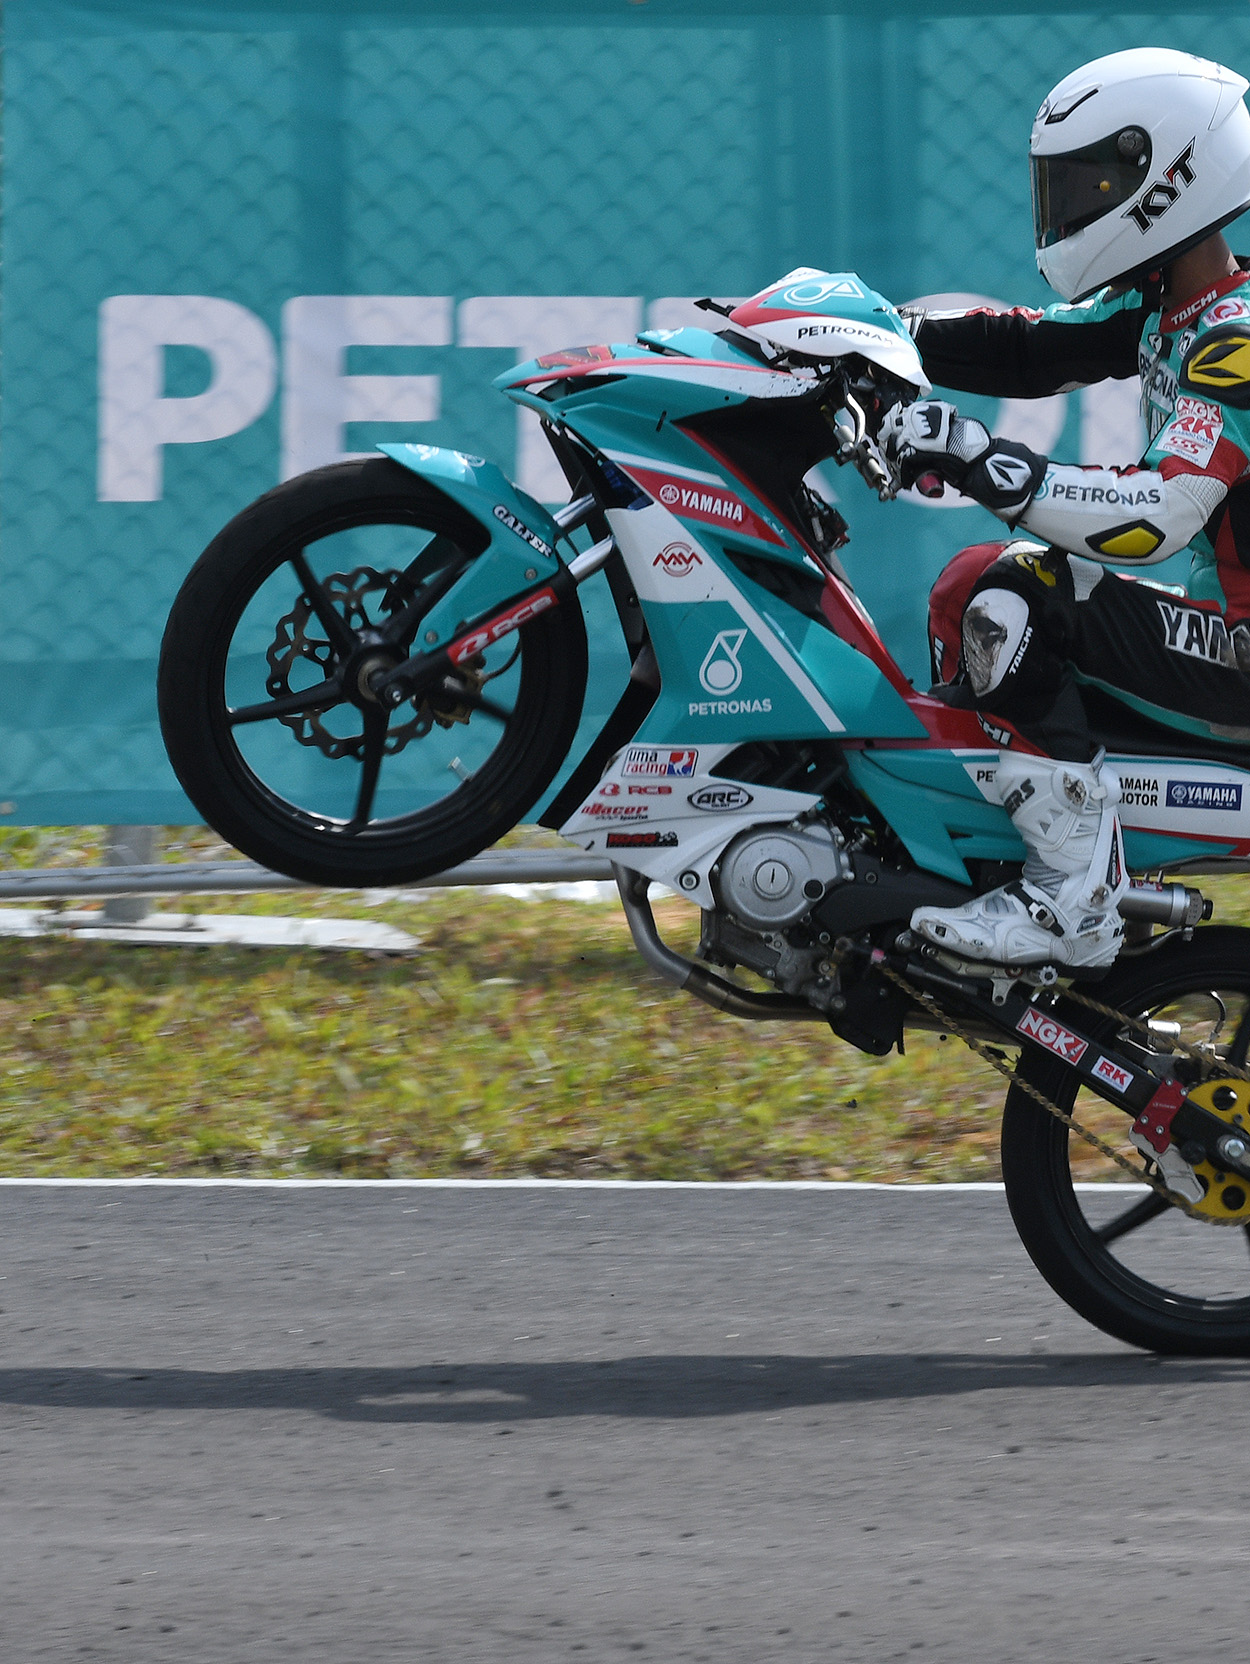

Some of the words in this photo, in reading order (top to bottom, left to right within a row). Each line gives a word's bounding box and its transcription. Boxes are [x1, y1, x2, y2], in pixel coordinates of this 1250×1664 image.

[1120, 135, 1197, 236] KYT
[1170, 289, 1218, 326] TAICHI
[1177, 397, 1222, 423] NGK
[1169, 416, 1215, 442] RK
[681, 488, 743, 523] YAMAHA
[1052, 483, 1161, 506] PETRONAS
[492, 504, 554, 558] GALFER
[1009, 625, 1034, 675] TAICHI
[688, 698, 772, 716] PETRONAS
[625, 761, 668, 776] racing
[628, 749, 658, 763] uma
[628, 785, 672, 795] RCB
[1118, 776, 1159, 792] AMAHA
[1187, 786, 1237, 803] YAMAHA
[1020, 1010, 1075, 1055] NGK
[1098, 1060, 1129, 1086] RK
